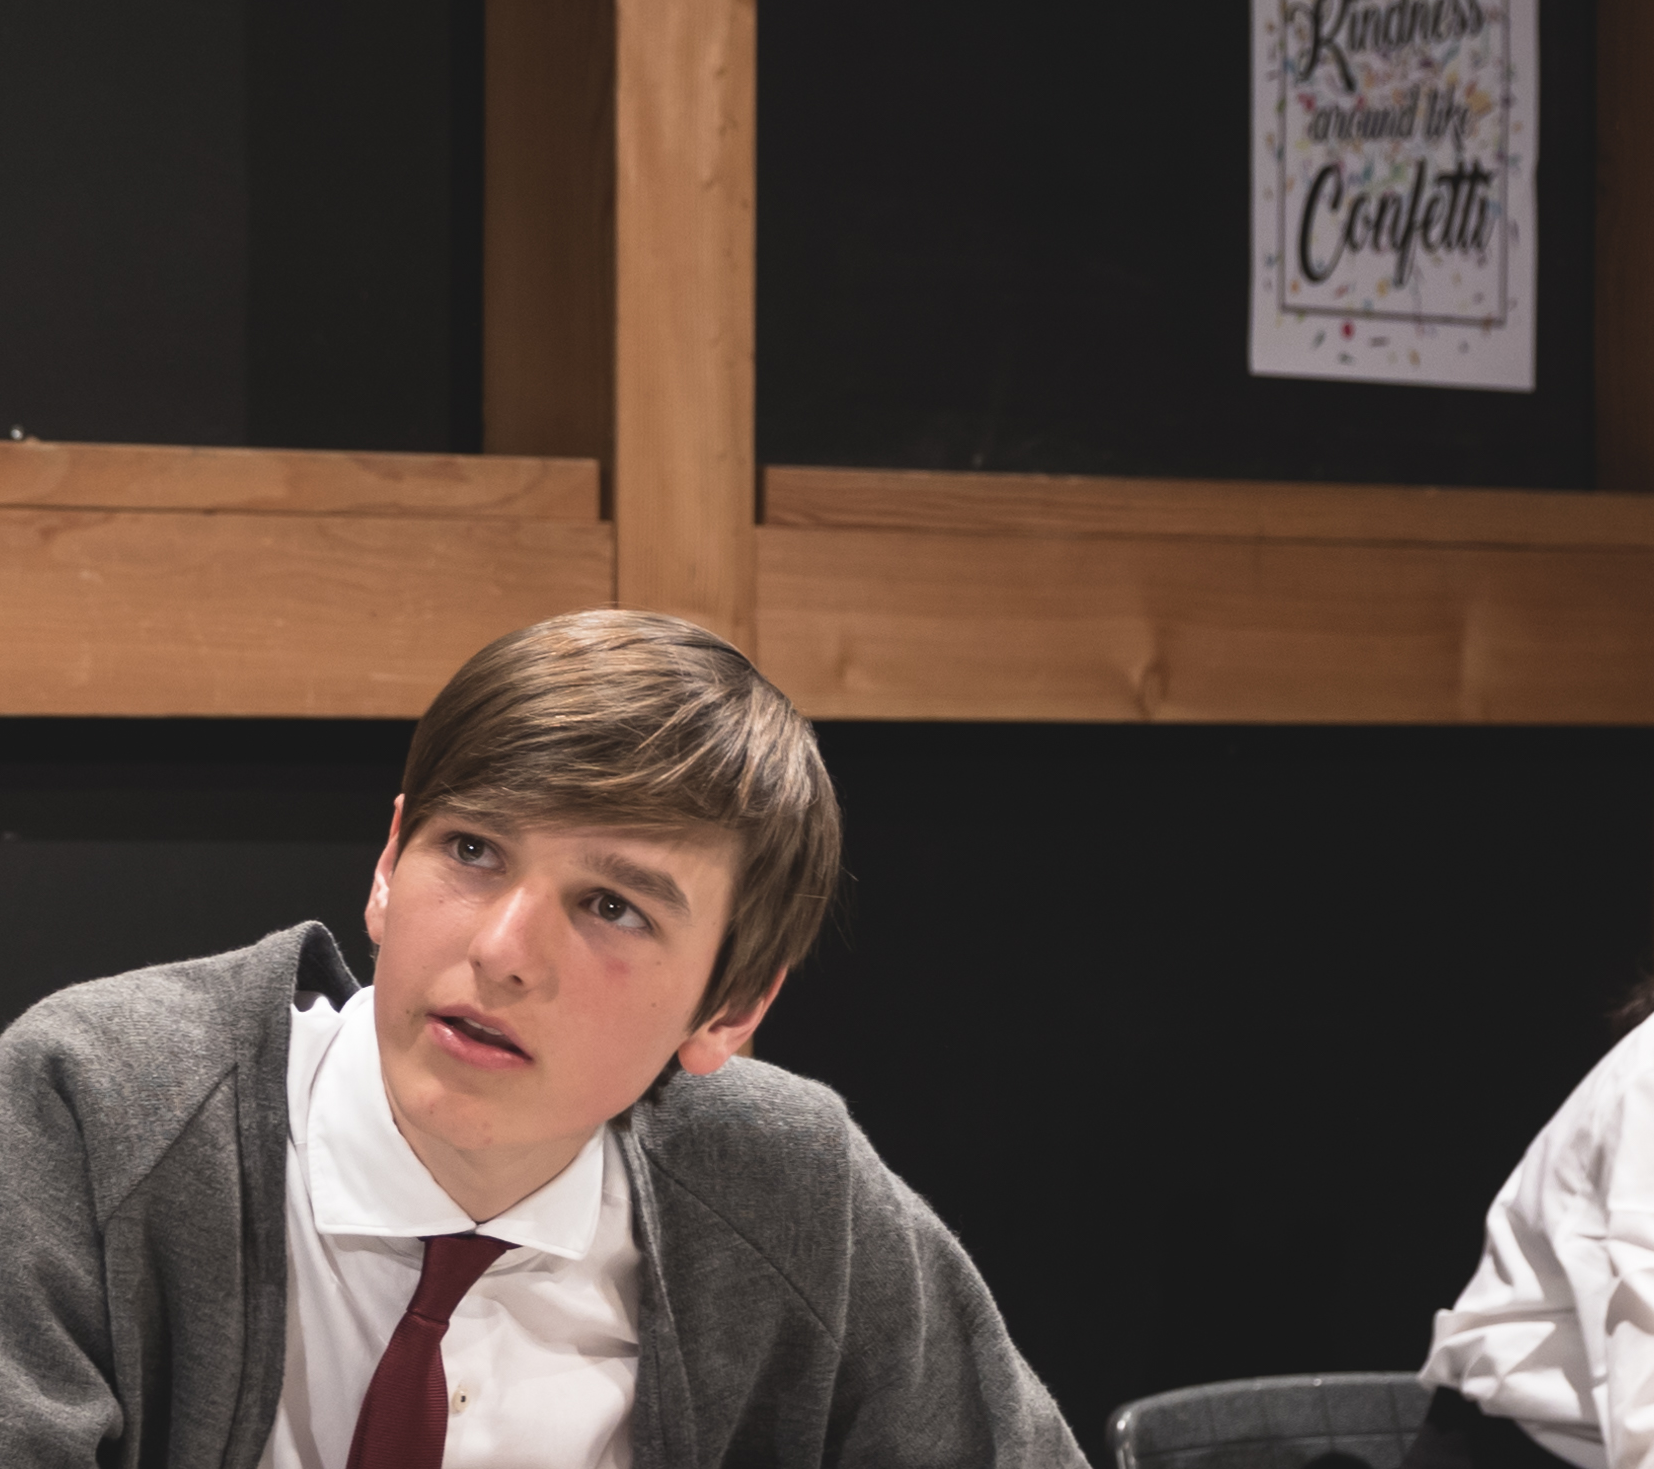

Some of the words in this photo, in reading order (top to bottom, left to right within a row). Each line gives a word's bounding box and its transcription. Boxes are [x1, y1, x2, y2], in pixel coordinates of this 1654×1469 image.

[1307, 82, 1422, 144] around
[1424, 85, 1469, 160] like
[1299, 153, 1493, 290] Confetti
